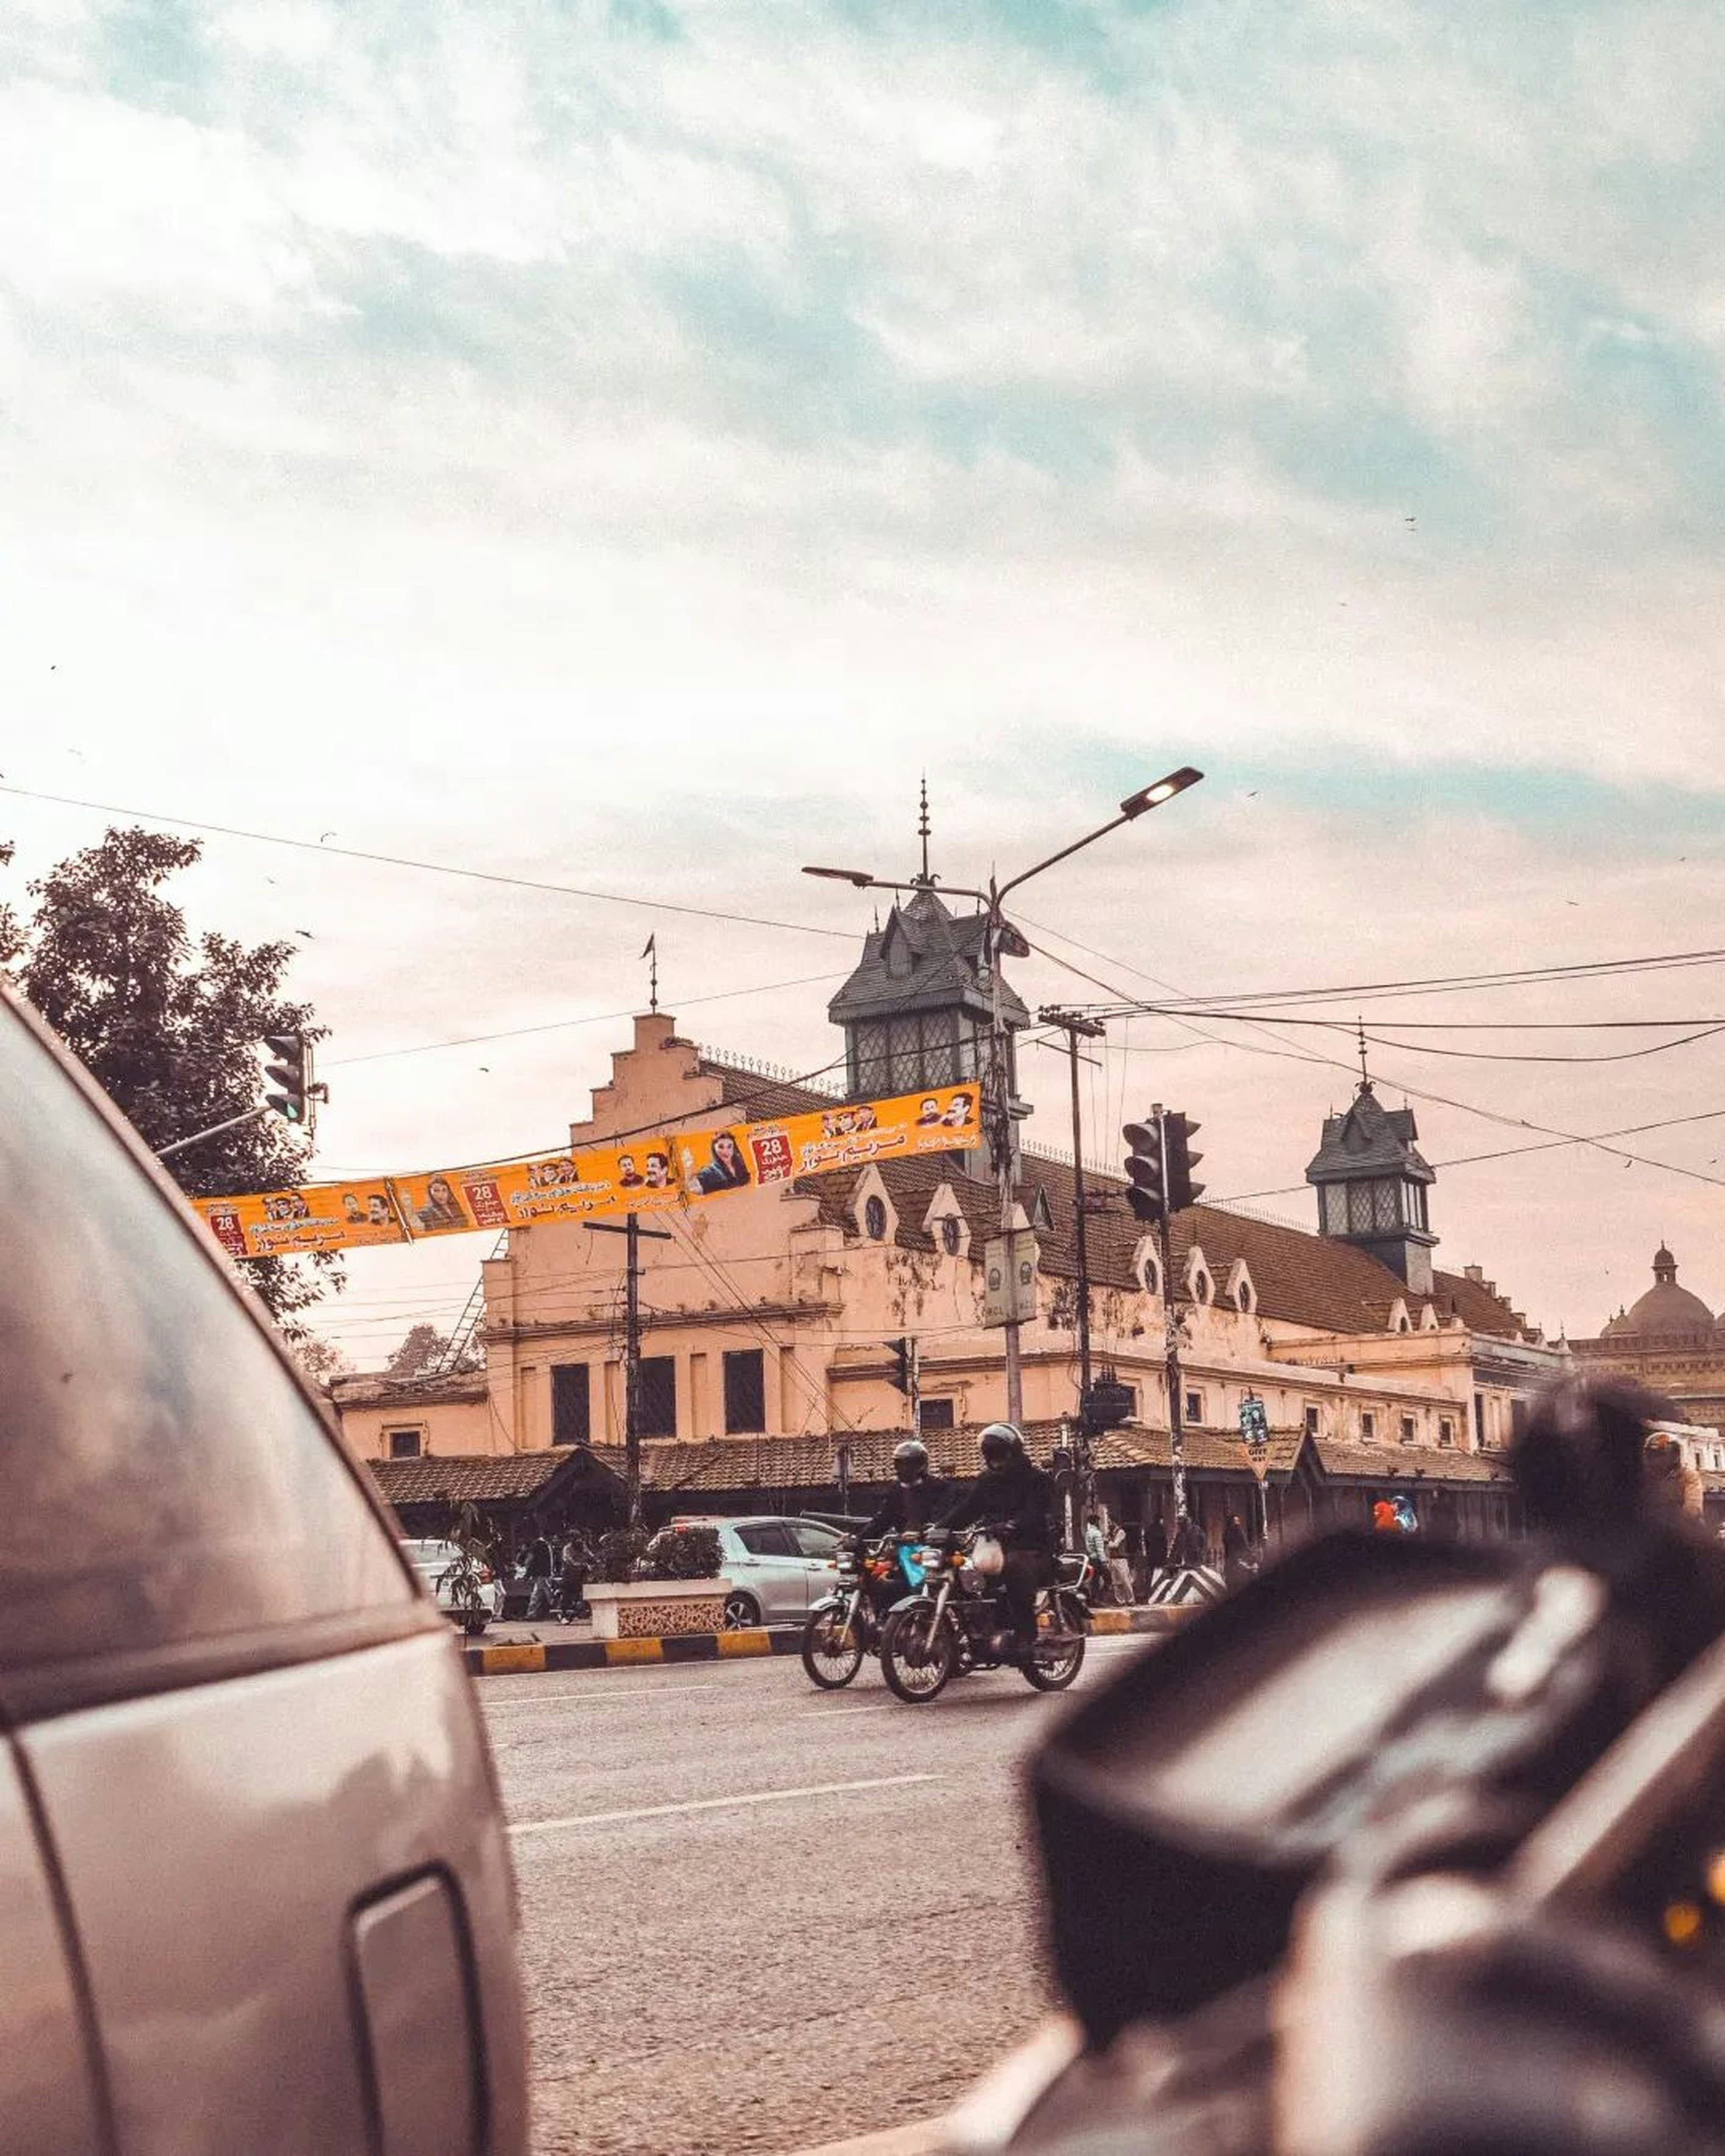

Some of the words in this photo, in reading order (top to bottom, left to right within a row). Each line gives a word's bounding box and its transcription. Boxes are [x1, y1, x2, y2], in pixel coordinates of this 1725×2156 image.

[760, 1139, 782, 1156] 28
[472, 1185, 493, 1201] 28
[216, 1216, 234, 1230] 28
